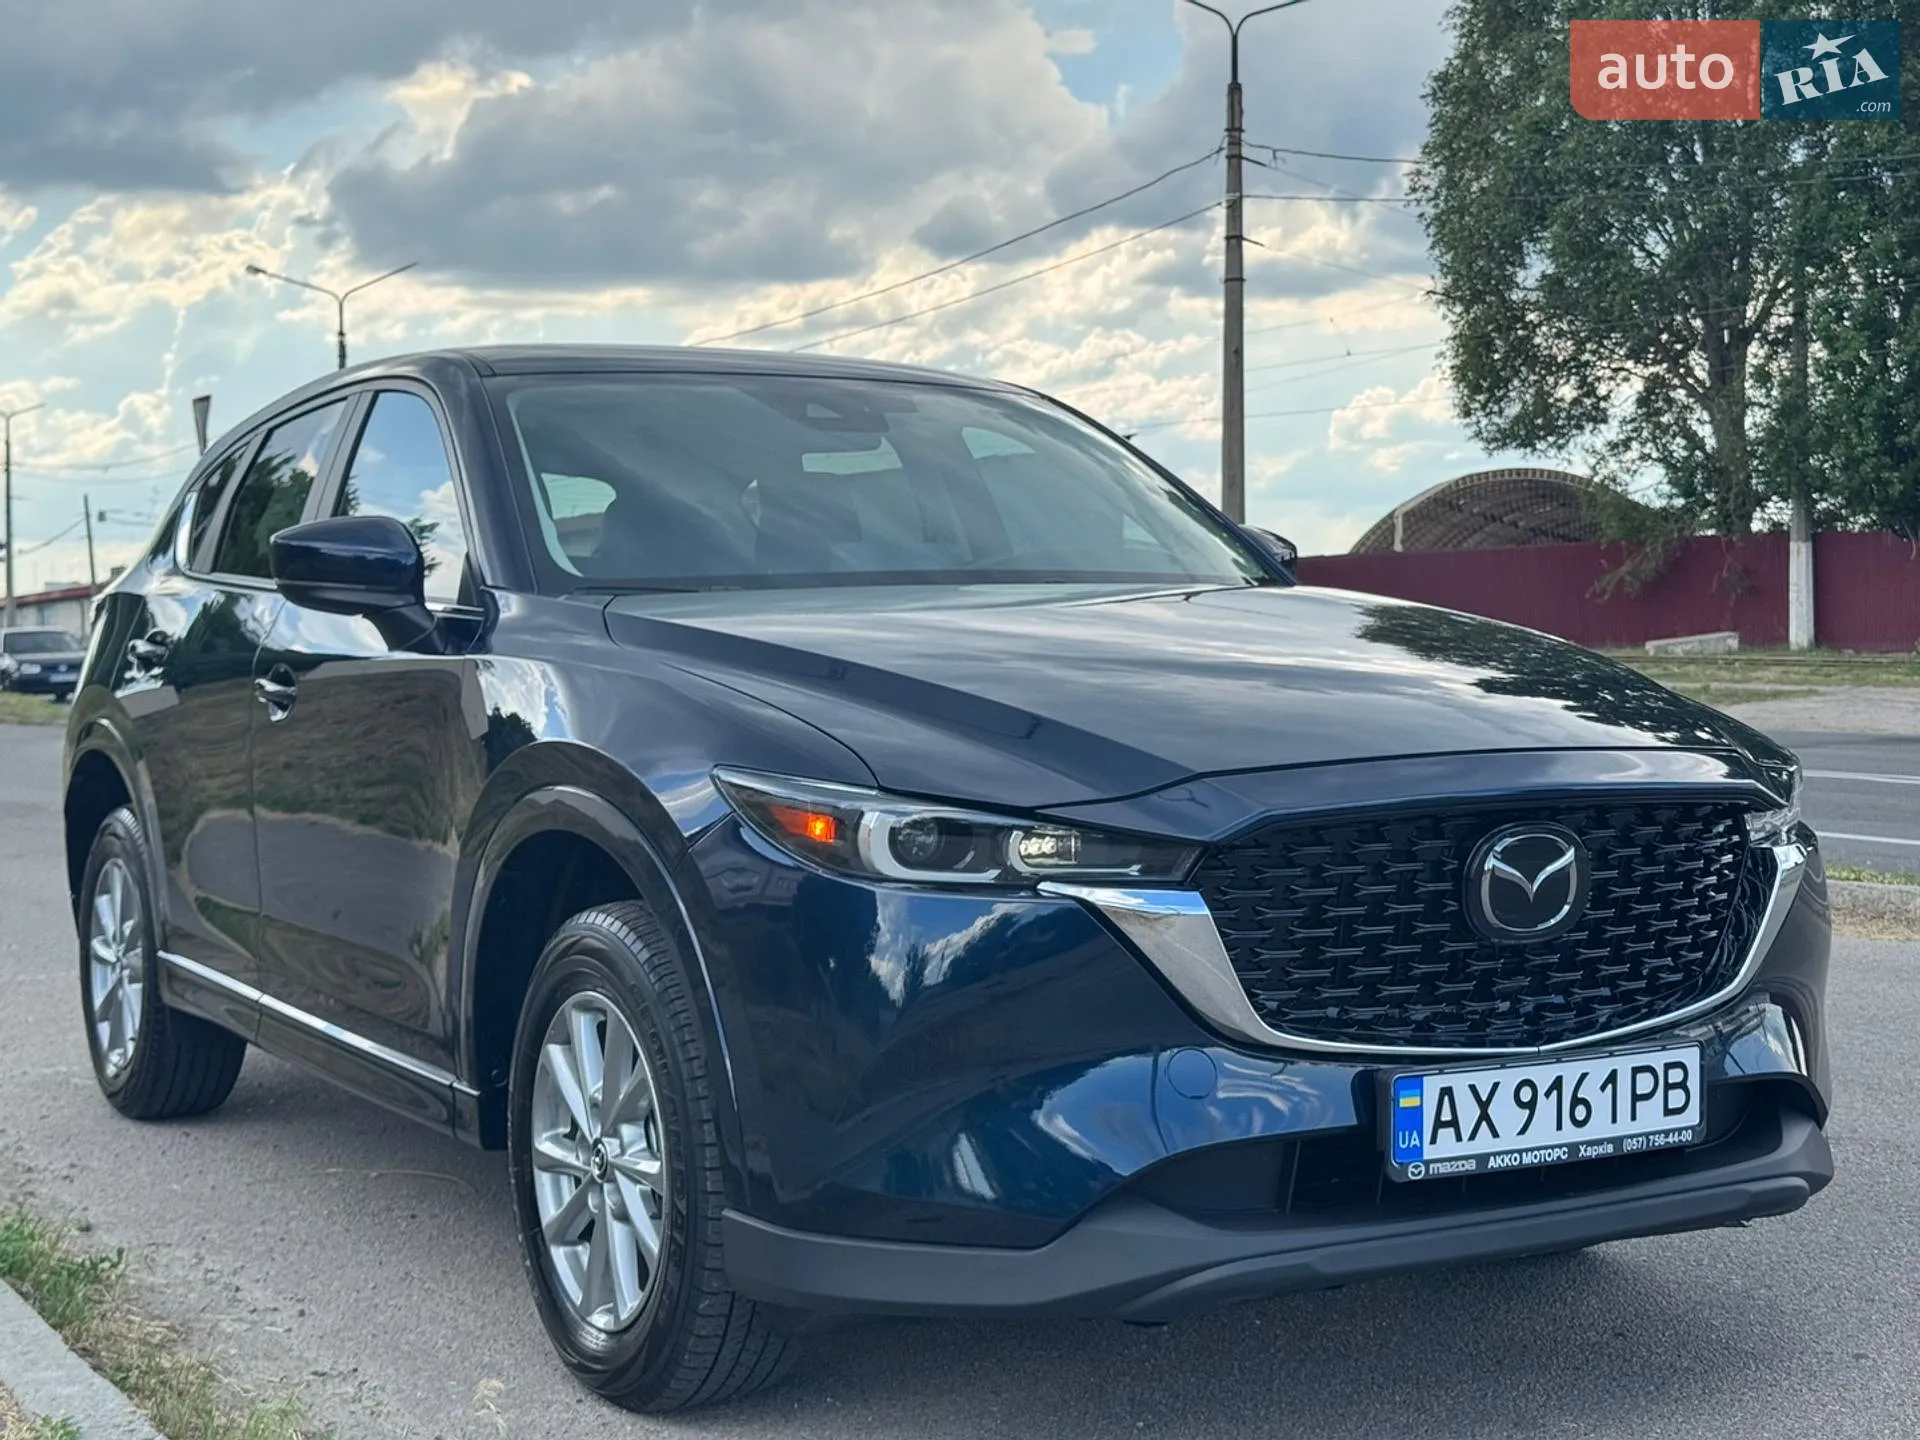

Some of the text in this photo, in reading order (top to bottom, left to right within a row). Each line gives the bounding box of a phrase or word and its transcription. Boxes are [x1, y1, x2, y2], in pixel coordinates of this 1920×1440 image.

[1429, 1061, 1691, 1145] AX 9161 PB
[1399, 1130, 1420, 1149] UA
[1622, 1137, 1647, 1152] (057)
[1488, 1141, 1614, 1169] АККО МОТОРС Харків
[1429, 1158, 1476, 1174] mazda
